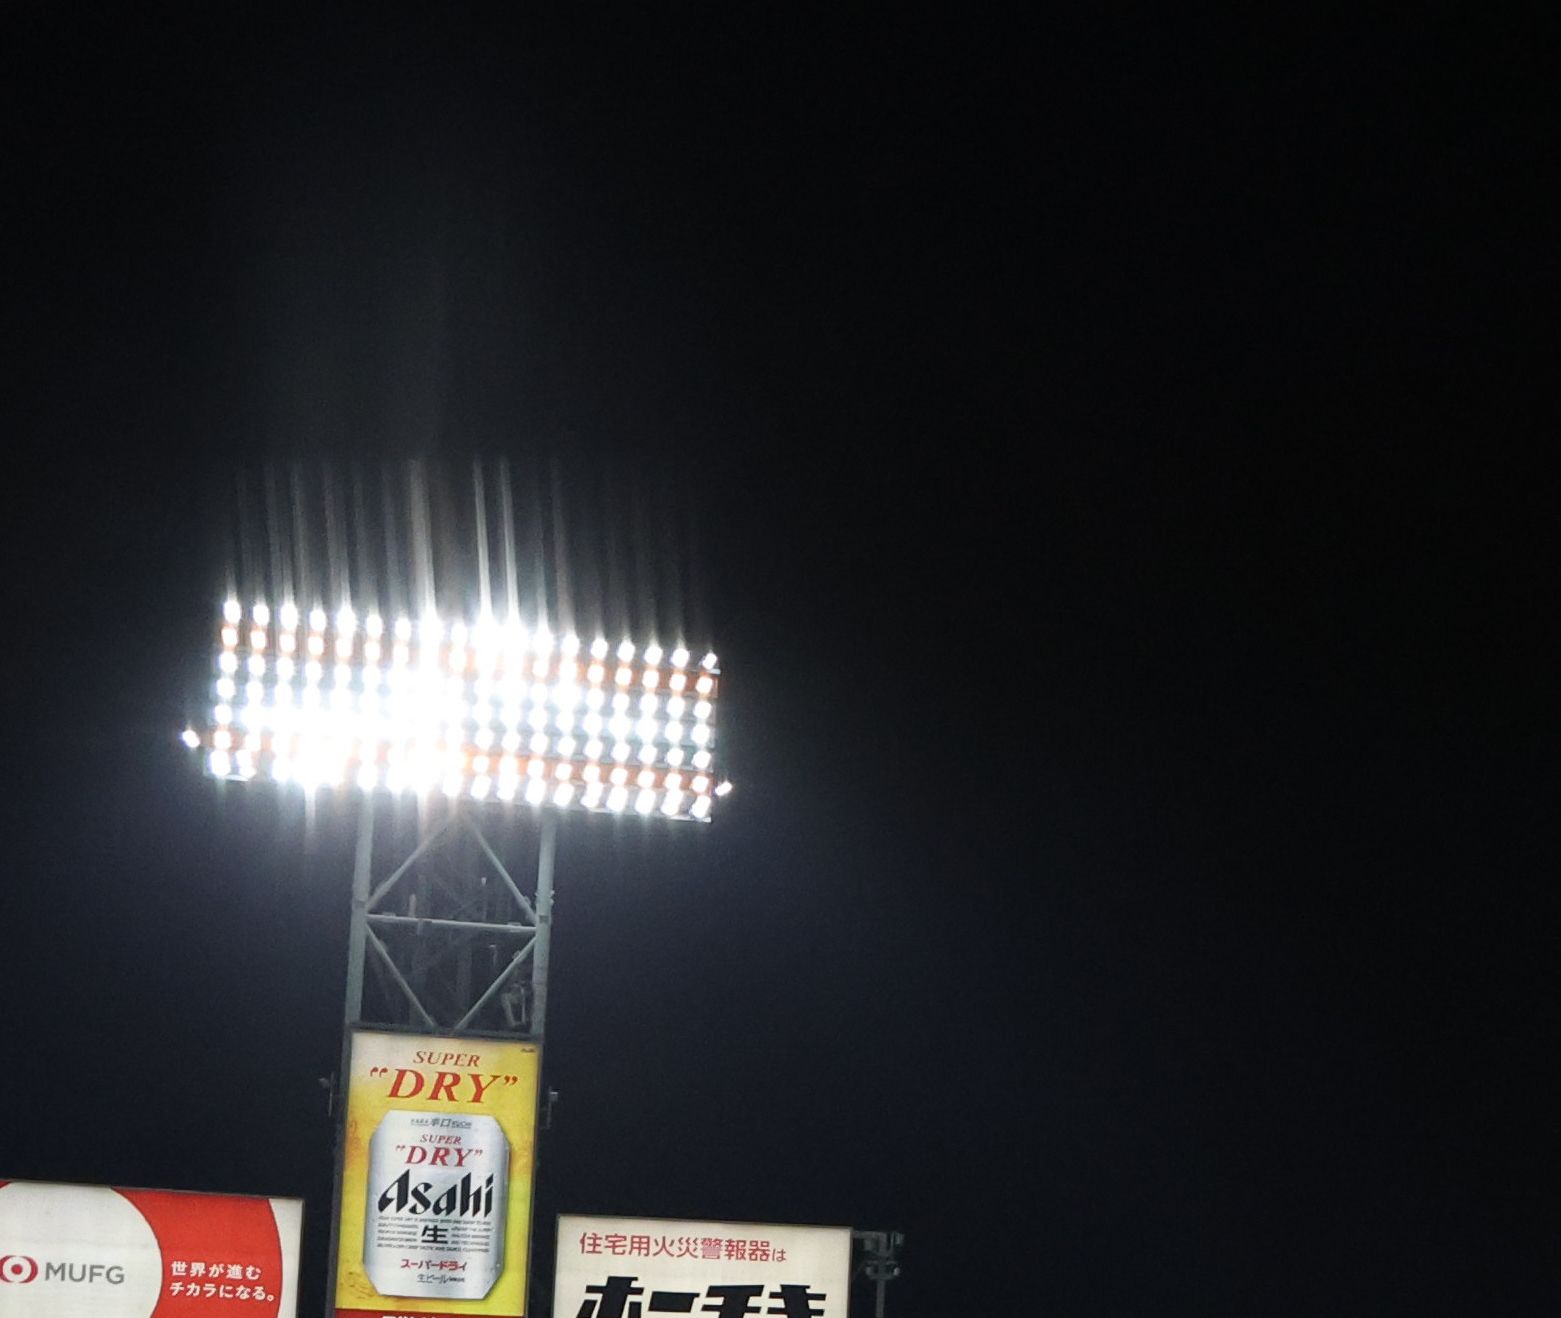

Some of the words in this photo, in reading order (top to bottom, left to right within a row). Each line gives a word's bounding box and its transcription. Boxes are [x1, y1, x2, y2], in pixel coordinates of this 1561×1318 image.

[413, 1050, 481, 1068] SUPER
[369, 1066, 519, 1104] “DRY”
[420, 1133, 463, 1145] SUPER
[378, 1169, 494, 1218] Asahi
[421, 1224, 449, 1245] 生
[579, 1232, 787, 1262] 住宅用火災警報器は
[44, 1261, 125, 1285] MUFG
[171, 1261, 261, 1281] 世界が進む
[400, 1258, 467, 1271] スーパードライ
[170, 1281, 275, 1302] チカラになる。
